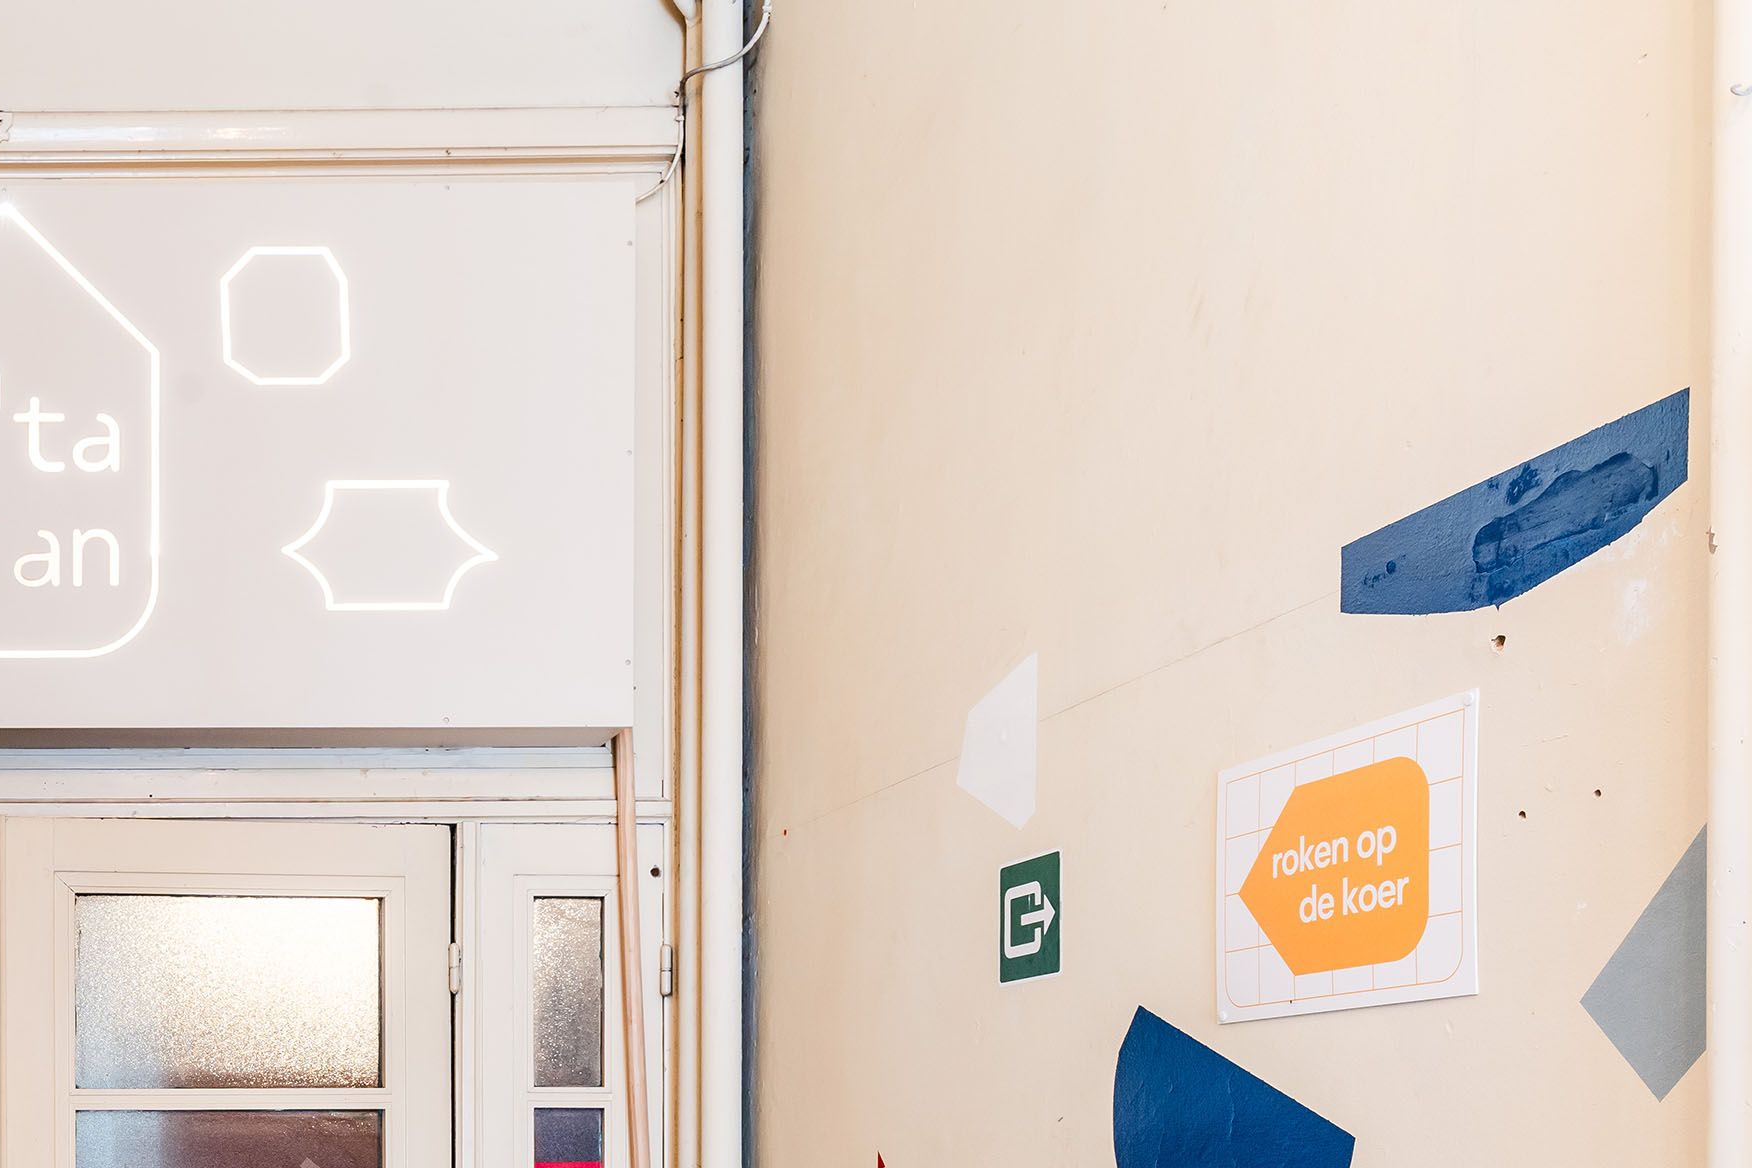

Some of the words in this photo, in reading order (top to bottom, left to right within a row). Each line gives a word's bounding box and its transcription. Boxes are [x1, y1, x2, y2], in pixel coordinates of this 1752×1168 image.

[1271, 834, 1349, 879] roken
[1355, 824, 1397, 867] op
[1299, 883, 1335, 924] de
[1342, 876, 1410, 916] koer
